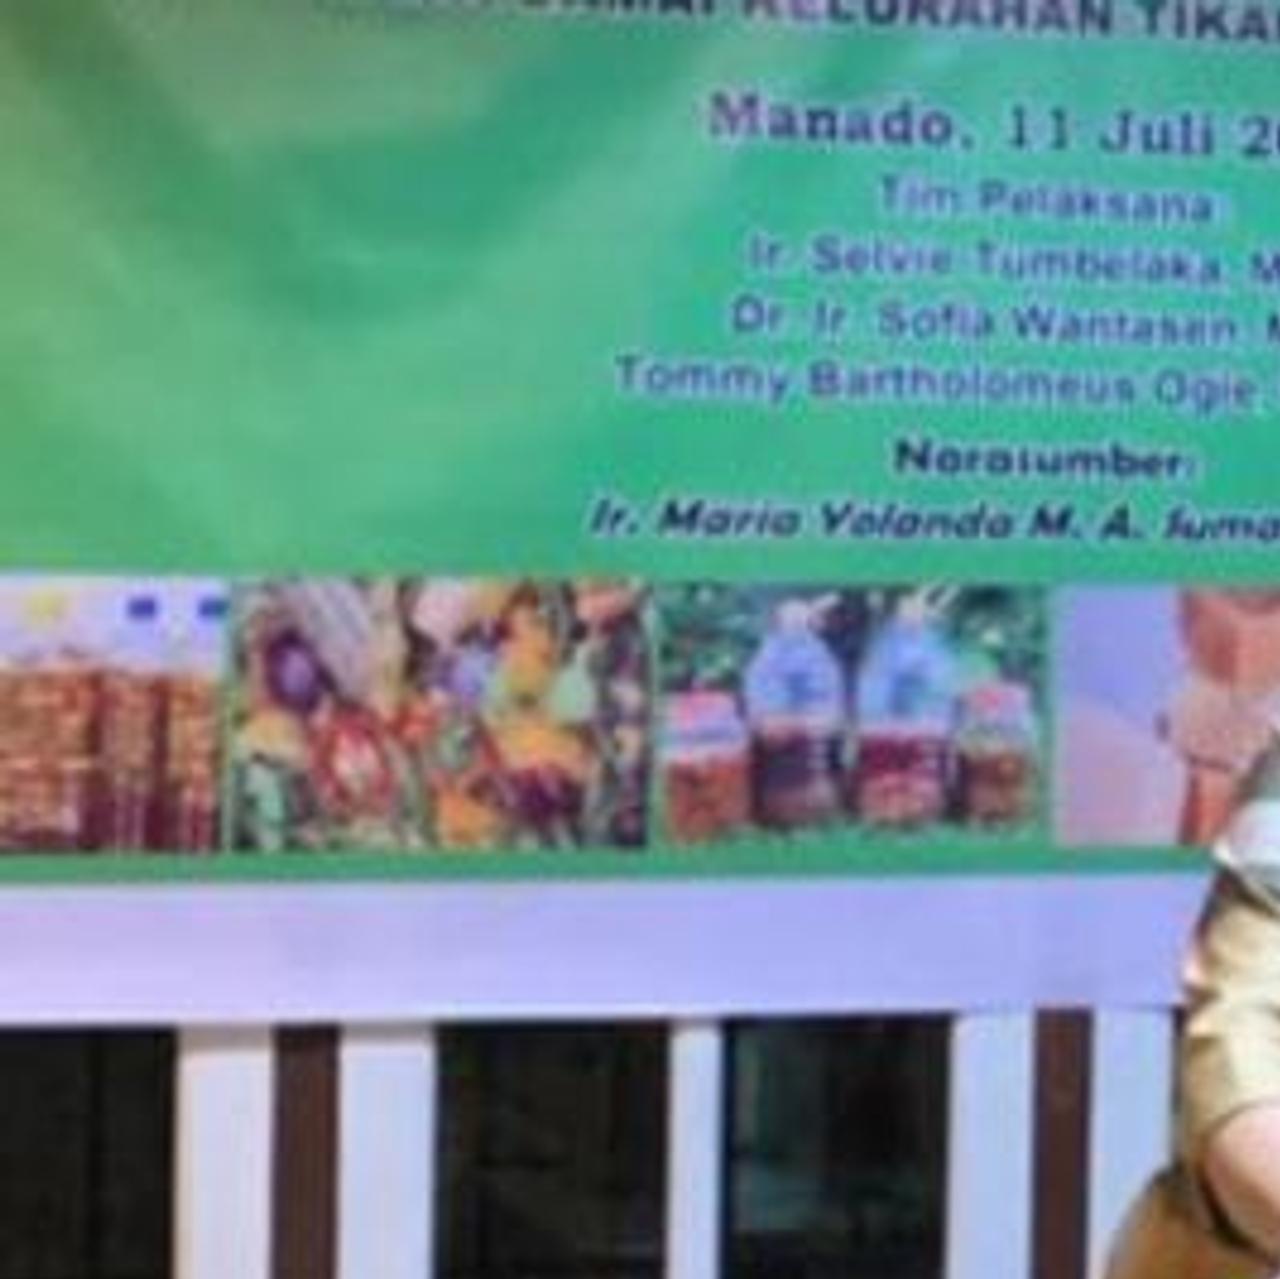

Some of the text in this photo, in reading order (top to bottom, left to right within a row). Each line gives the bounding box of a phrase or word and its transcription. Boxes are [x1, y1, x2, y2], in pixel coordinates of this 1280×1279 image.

[742, 0, 1112, 37] KELURAHAN
[1012, 106, 1072, 151] 11
[1100, 111, 1216, 156] Juli
[880, 173, 959, 211] Tim
[615, 354, 790, 402] Tommy
[808, 360, 1136, 400] Bartholomeus
[656, 500, 798, 537] Maria
[822, 502, 1014, 539] Yolanda
[1101, 504, 1144, 539] A.
